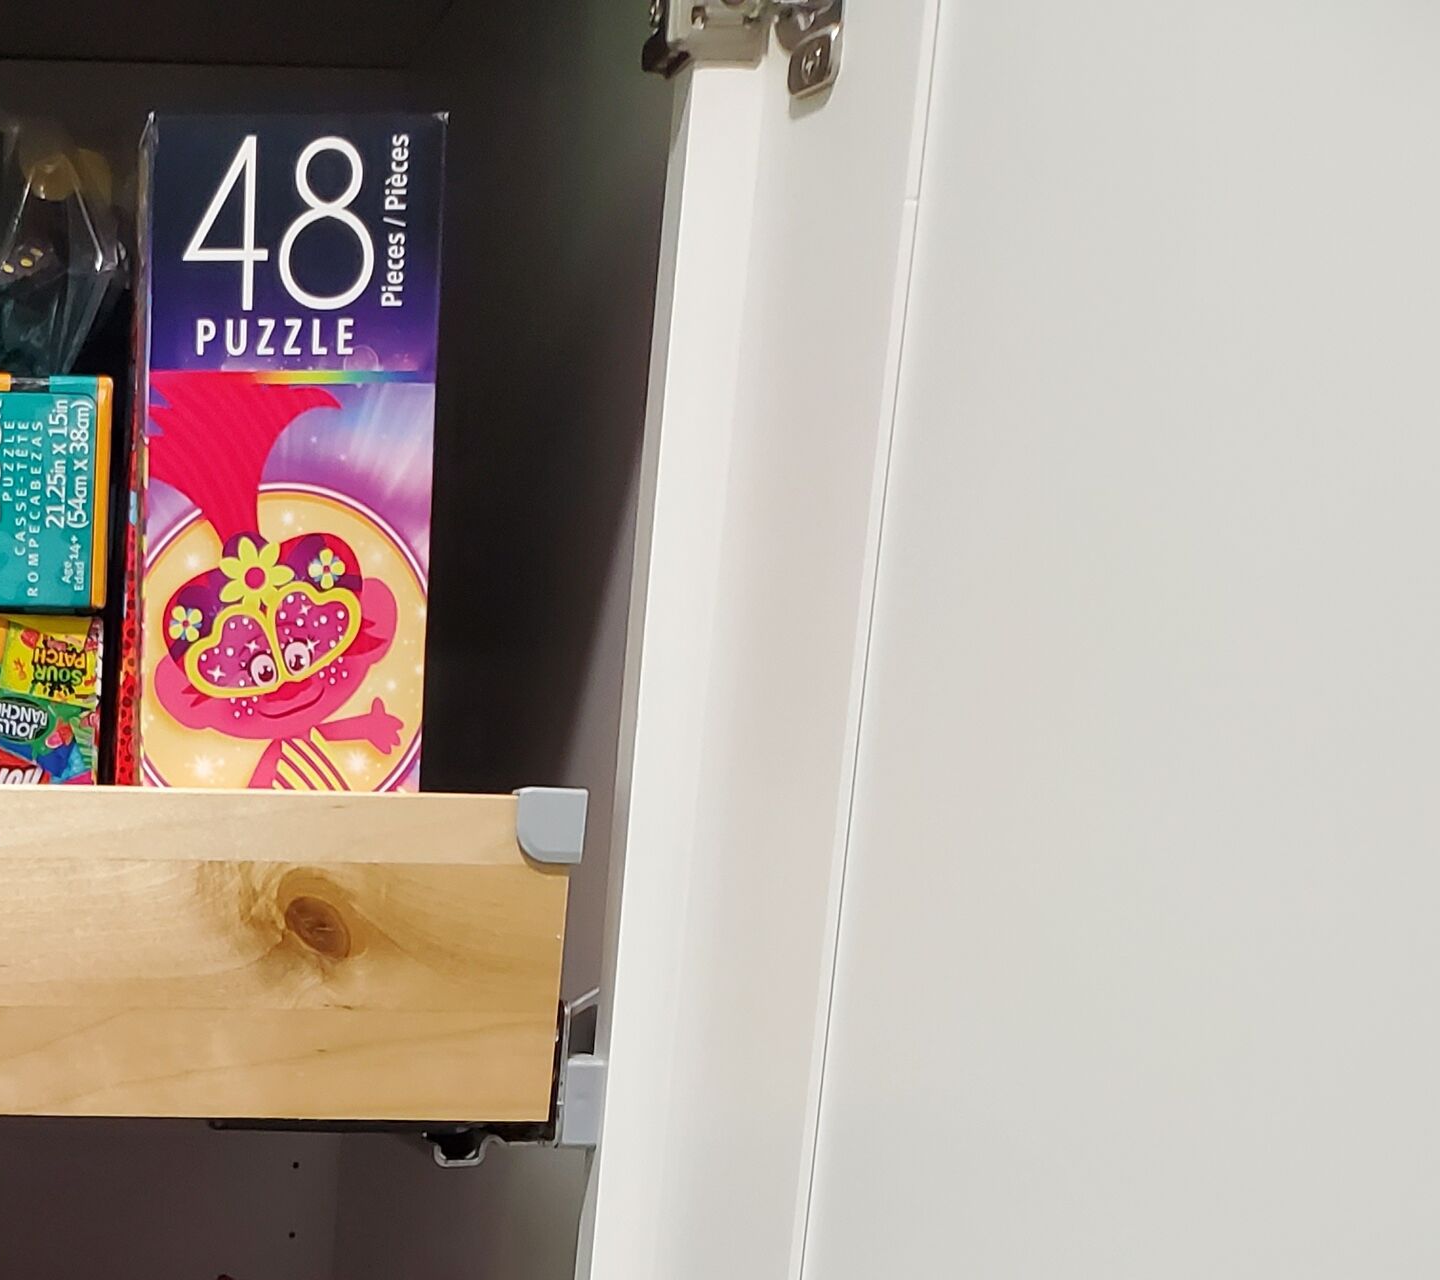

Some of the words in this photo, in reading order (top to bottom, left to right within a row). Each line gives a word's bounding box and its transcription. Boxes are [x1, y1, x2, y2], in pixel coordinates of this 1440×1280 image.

[385, 133, 410, 211] Pièces
[182, 134, 375, 311] 48
[380, 232, 405, 307] Pieces
[196, 317, 355, 356] PUZZLE
[49, 400, 68, 437] 15in
[69, 400, 93, 454] 38cm)
[2, 421, 15, 502] PUZZLE
[14, 421, 30, 556] CASSE-TÊTE
[45, 460, 66, 529] 21.25in
[27, 421, 43, 597] ROMPECABEZAS
[66, 476, 89, 529] (54cm
[31, 648, 89, 667] PATCH
[33, 665, 83, 682] SOUR
